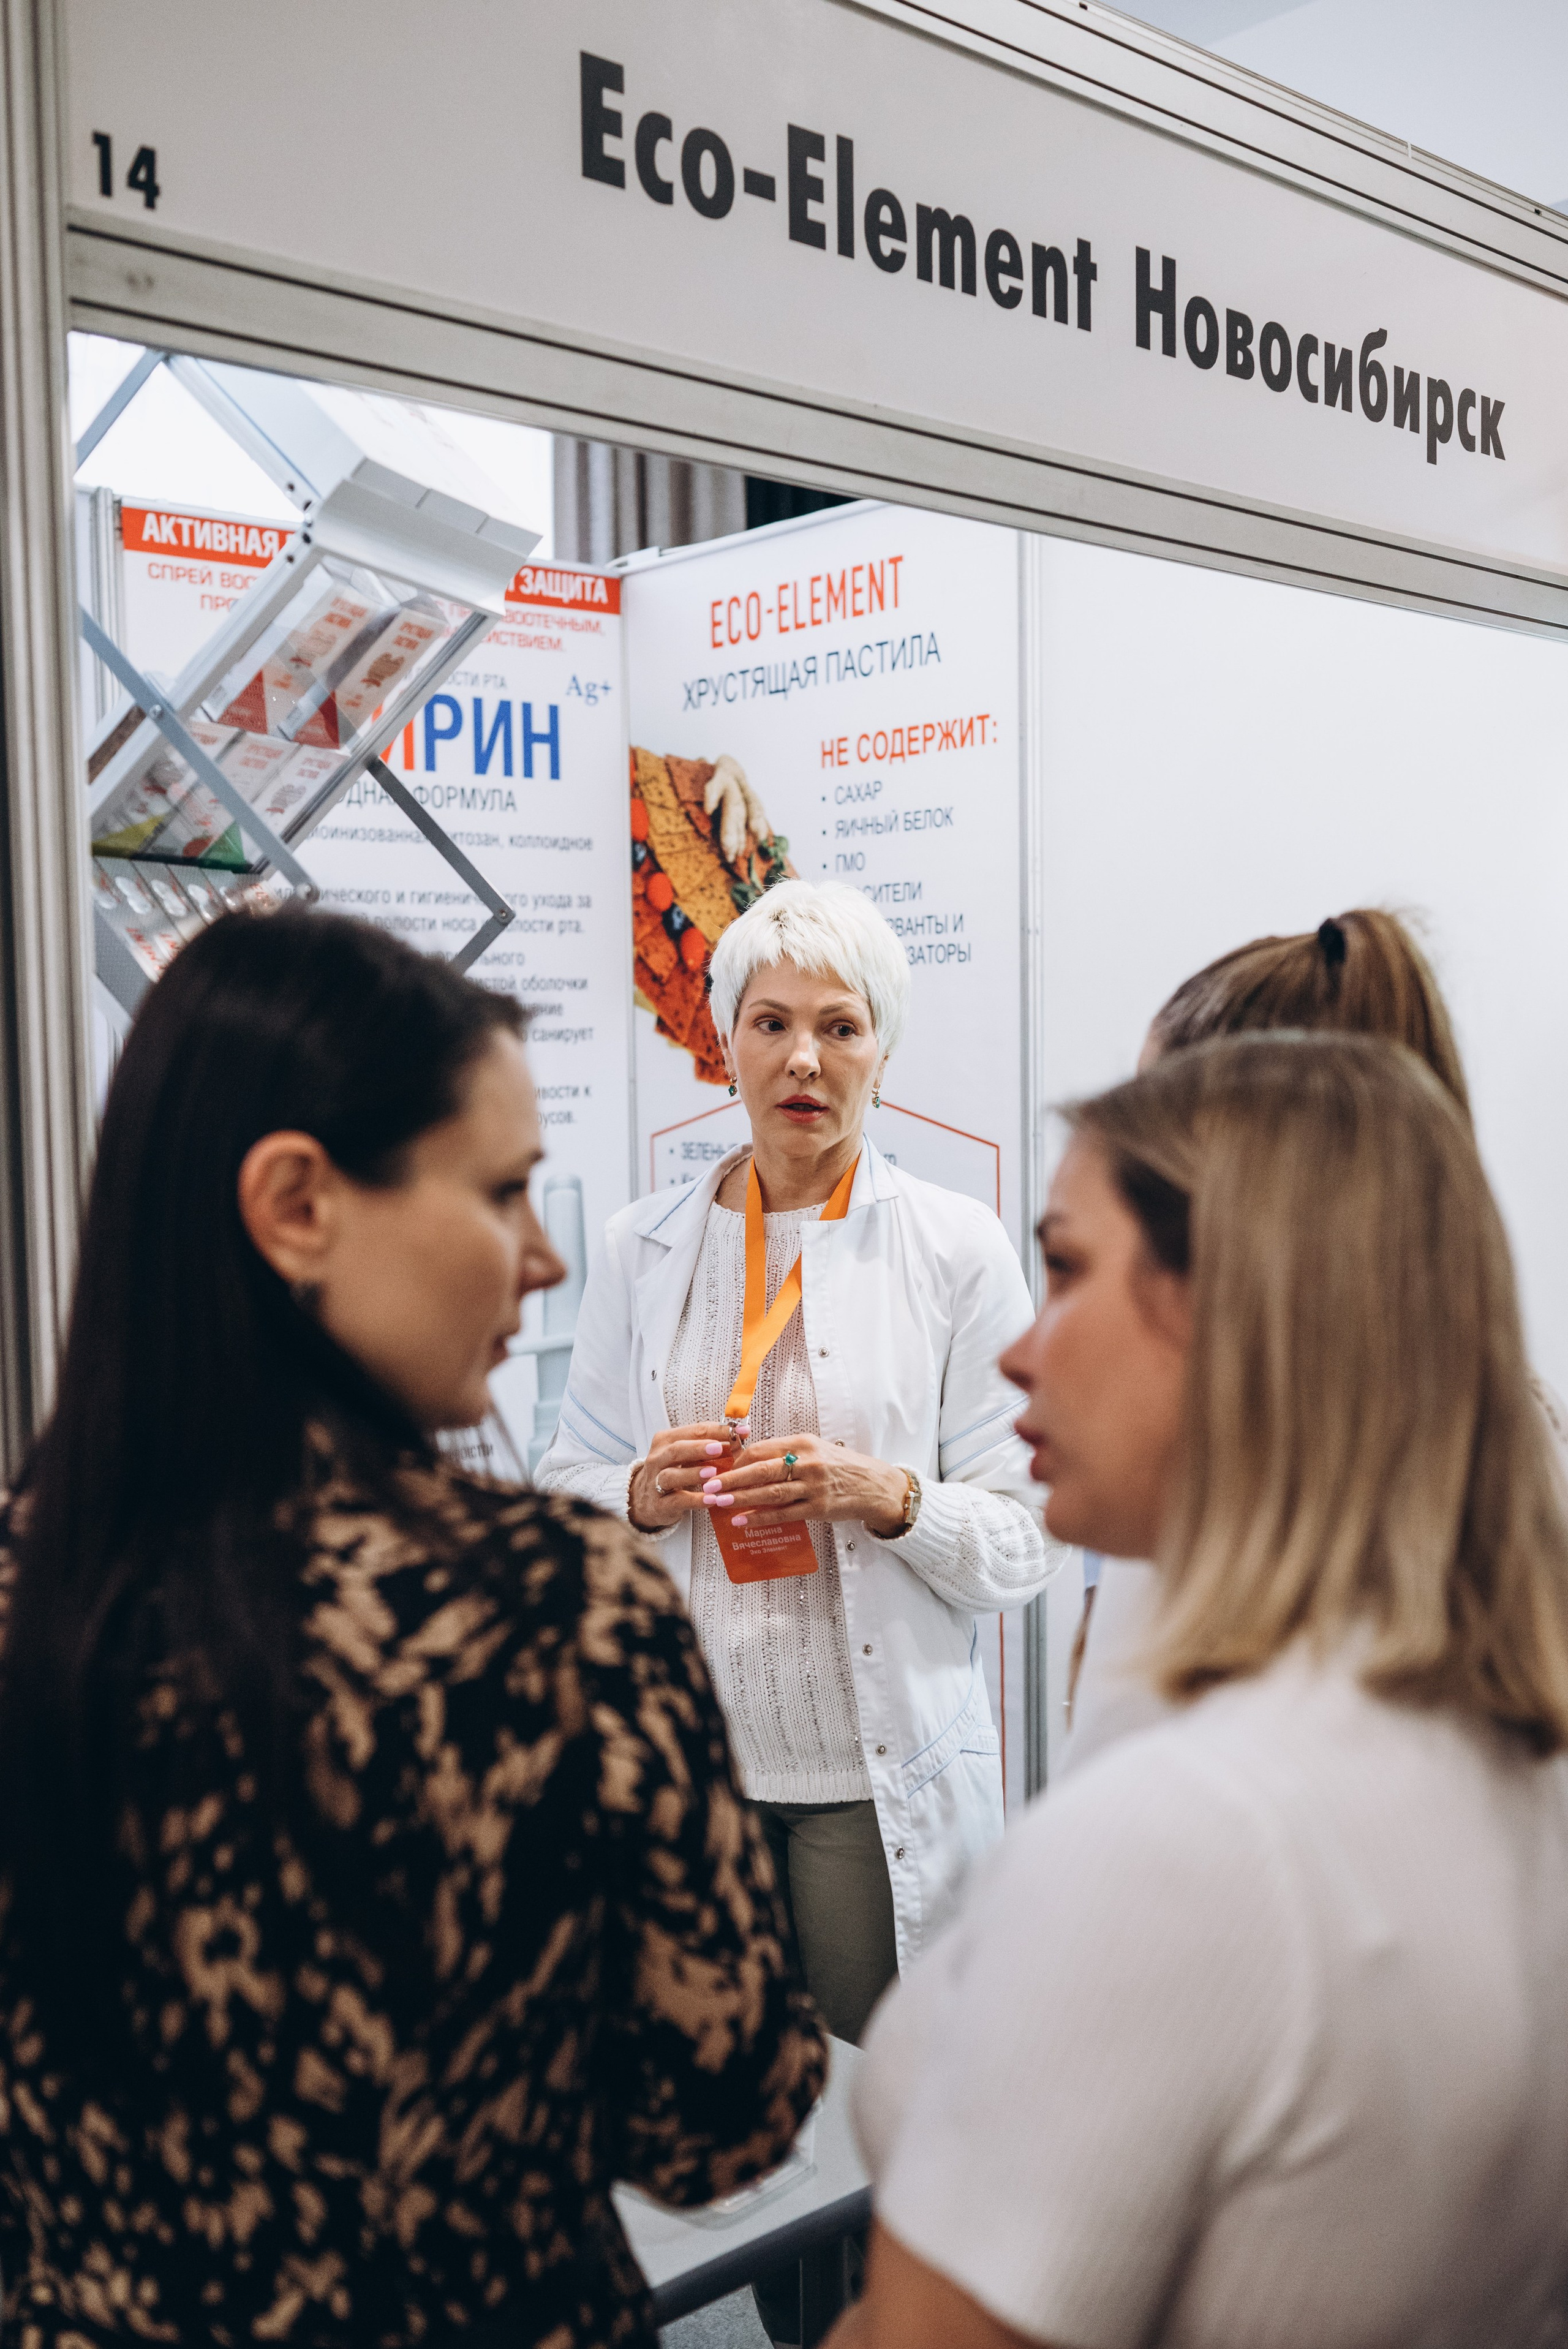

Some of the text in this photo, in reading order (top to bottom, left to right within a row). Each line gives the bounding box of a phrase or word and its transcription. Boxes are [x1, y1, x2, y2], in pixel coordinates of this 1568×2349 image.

[92, 130, 160, 210] 14
[580, 50, 1506, 466] Eco-Element Новосибирск
[141, 512, 280, 559] АКТИВНАЯ
[147, 562, 213, 586] СПРЕЙ
[519, 567, 608, 605] ЗАЩИТА
[710, 555, 903, 649] ECO-ELEMENT
[682, 632, 941, 712] ХРУСТЯЩАЯ ПАСТИЛА
[566, 674, 612, 705] Ag+
[821, 714, 998, 769] НЕ СОДЕРЖИТ:
[413, 785, 518, 813] ФОРМУЛА
[834, 780, 883, 805] САХАР
[835, 807, 954, 839] ЯИЧНЫЙ БЕЛОК
[835, 851, 866, 873] ГМО
[953, 913, 964, 933] И
[731, 1534, 801, 1551] Вячеславовна
[744, 1526, 783, 1539] Марина
